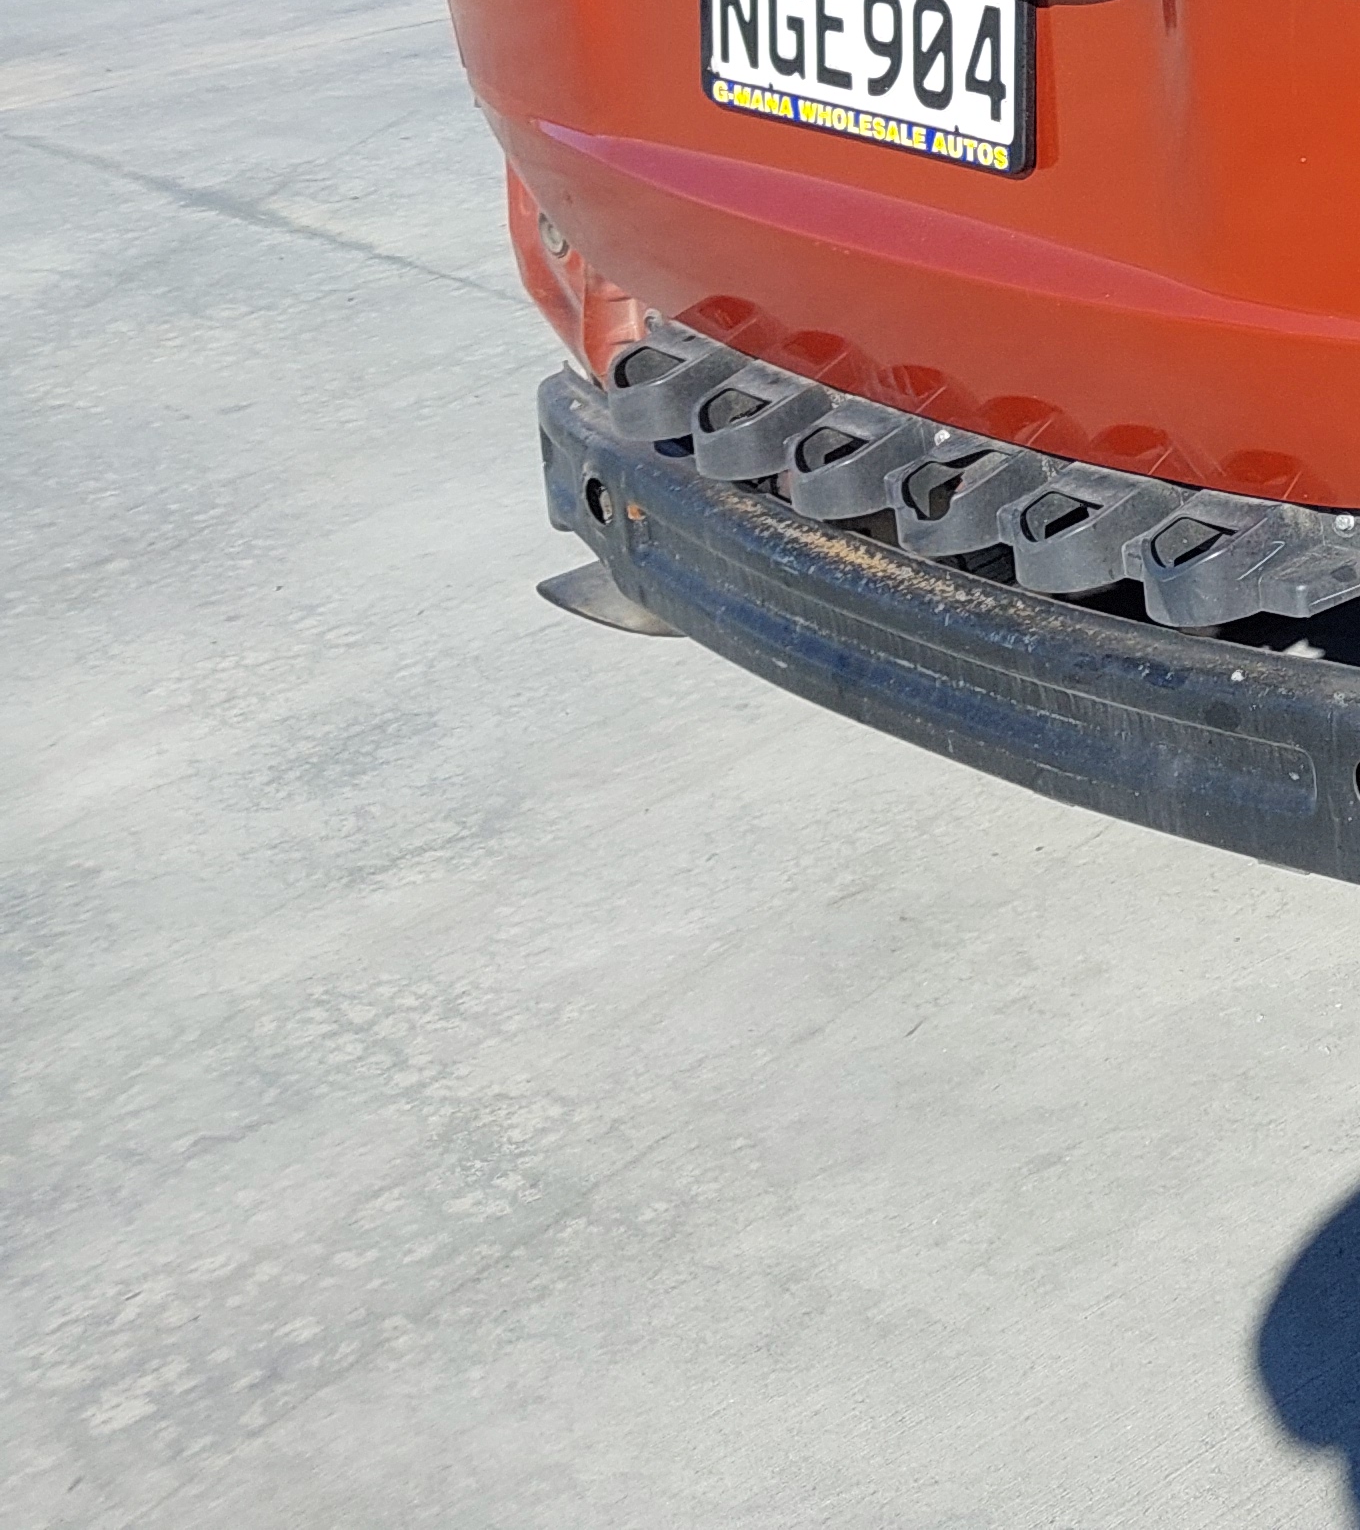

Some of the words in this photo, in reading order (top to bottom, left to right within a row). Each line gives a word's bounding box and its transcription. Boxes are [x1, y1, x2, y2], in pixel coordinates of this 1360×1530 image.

[712, 80, 794, 119] G-MANA
[797, 99, 927, 150] WHOLESALE
[930, 131, 1010, 170] AUTOS
